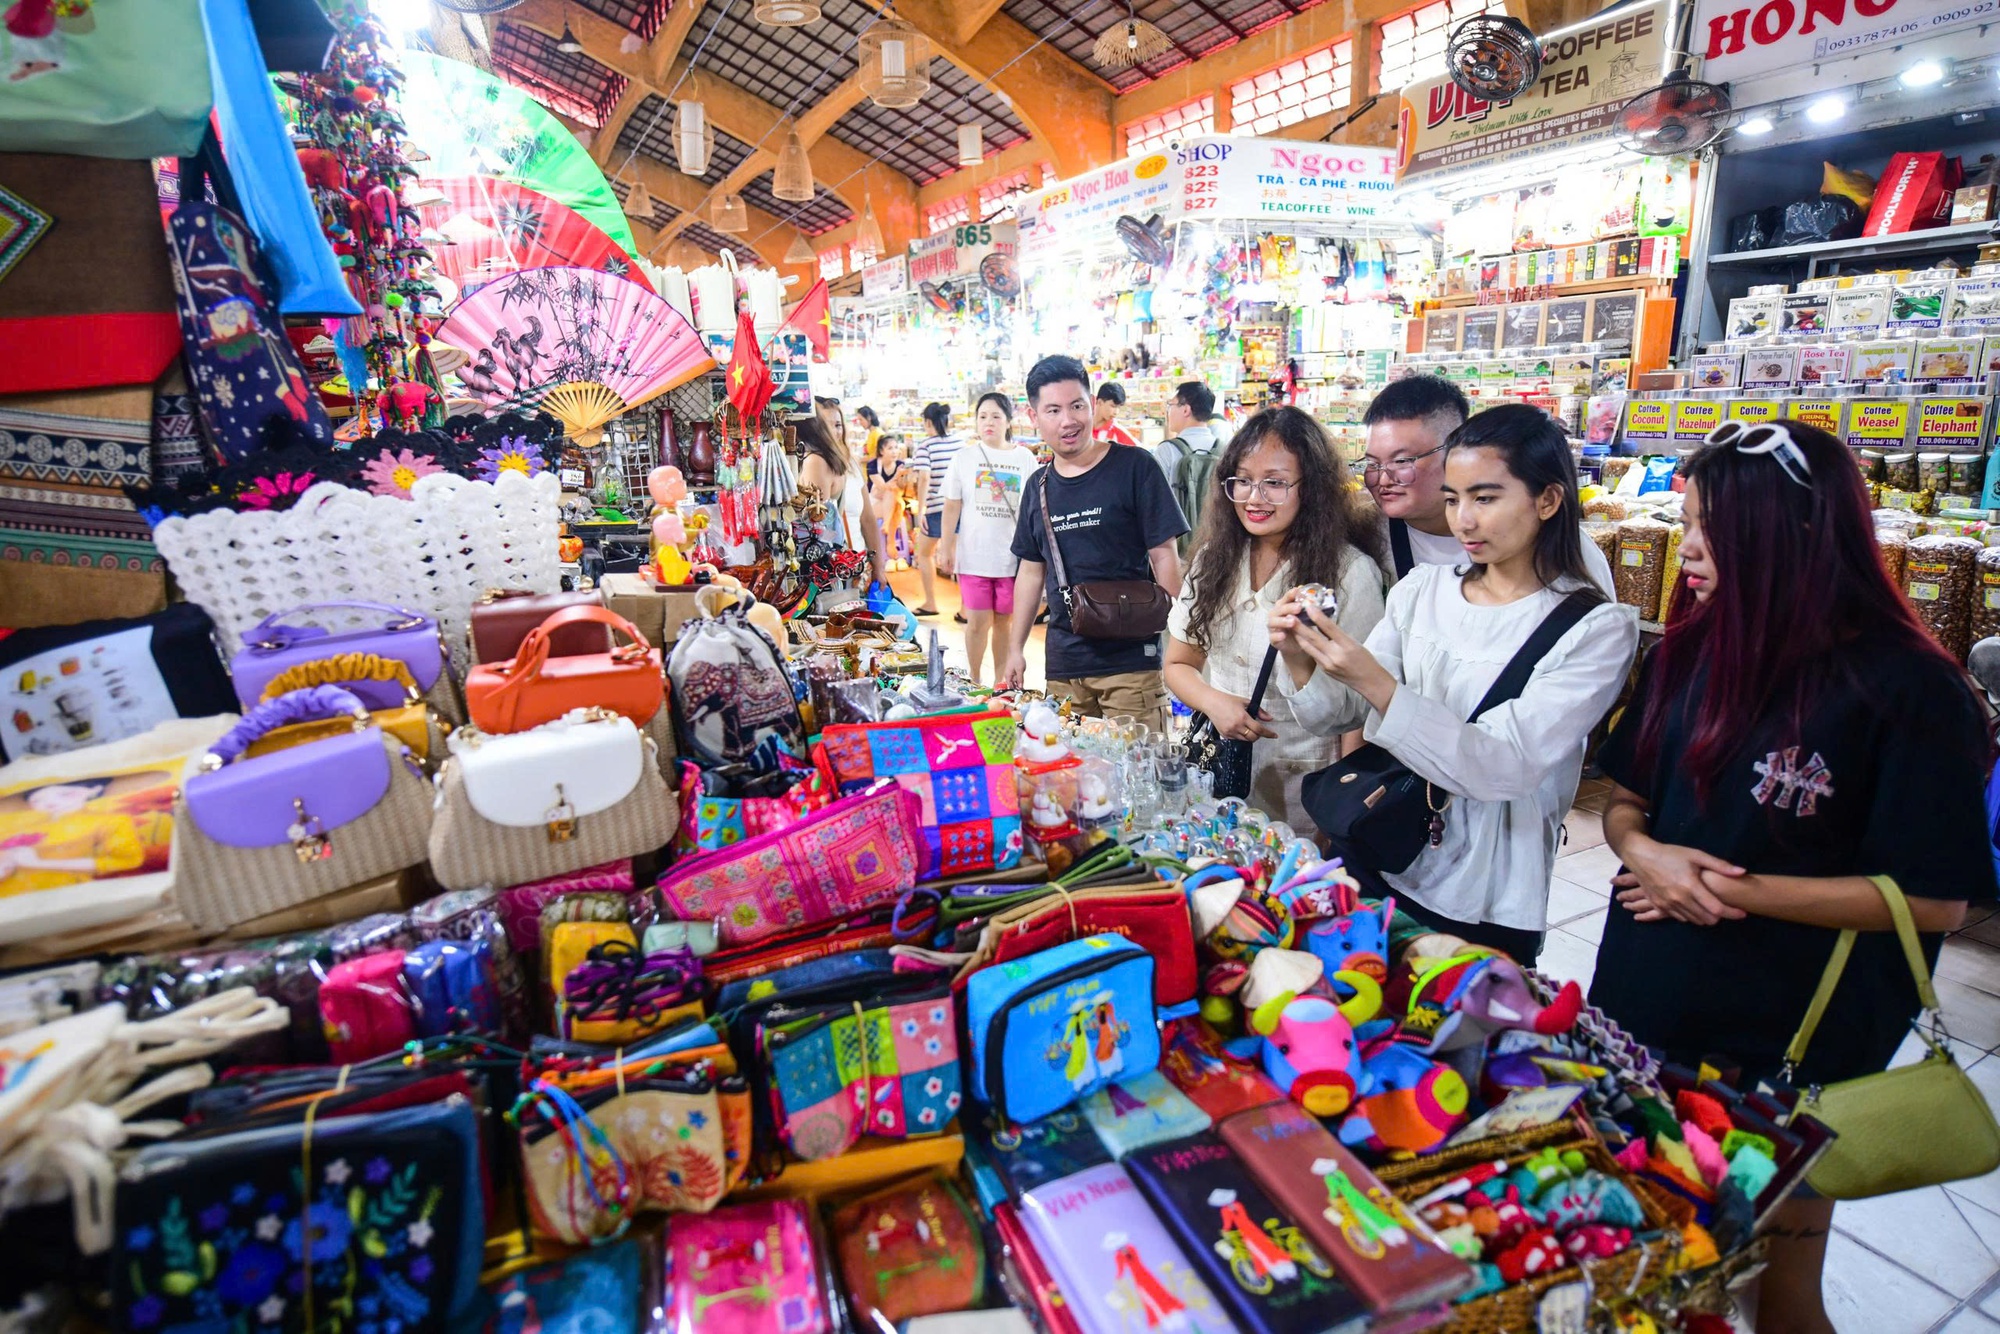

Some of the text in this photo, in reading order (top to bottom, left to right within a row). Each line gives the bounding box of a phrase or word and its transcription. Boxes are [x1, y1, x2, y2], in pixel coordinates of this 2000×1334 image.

[1829, 2, 1994, 51] 0933 78 74 06 0909 92
[1543, 10, 1655, 66] COFFEE
[1540, 65, 1590, 98] TEA
[1449, 106, 1553, 142] From Vietnam With Love
[1177, 143, 1232, 166] SHOP
[1184, 165, 1219, 179] 823
[1256, 173, 1285, 185] TRÀ
[1300, 175, 1317, 187] CÀ
[1322, 178, 1348, 189] PHÊ
[1044, 192, 1068, 209] 823
[1104, 168, 1130, 191] Hoa
[1184, 181, 1219, 195] 825
[1184, 197, 1218, 211] 827
[1347, 206, 1377, 215] WINE
[955, 224, 992, 248] 865
[1957, 283, 1986, 291] White
[1783, 297, 1810, 306] Lychee
[1835, 291, 1882, 301] Jasmine Tea
[1804, 350, 1826, 358] Rose
[1697, 358, 1722, 366] Butterfly
[1638, 404, 1661, 414] Coffee
[1684, 406, 1713, 415] Coffee
[1740, 406, 1768, 415] Coffee
[1864, 406, 1892, 415] Coffee
[1924, 405, 1954, 415] Coffee
[1632, 414, 1665, 425] Coconut
[1678, 418, 1717, 429] Hazelnut
[1858, 417, 1899, 427] Weasel
[1922, 419, 1978, 434] Elephant
[1079, 518, 1101, 527] maker
